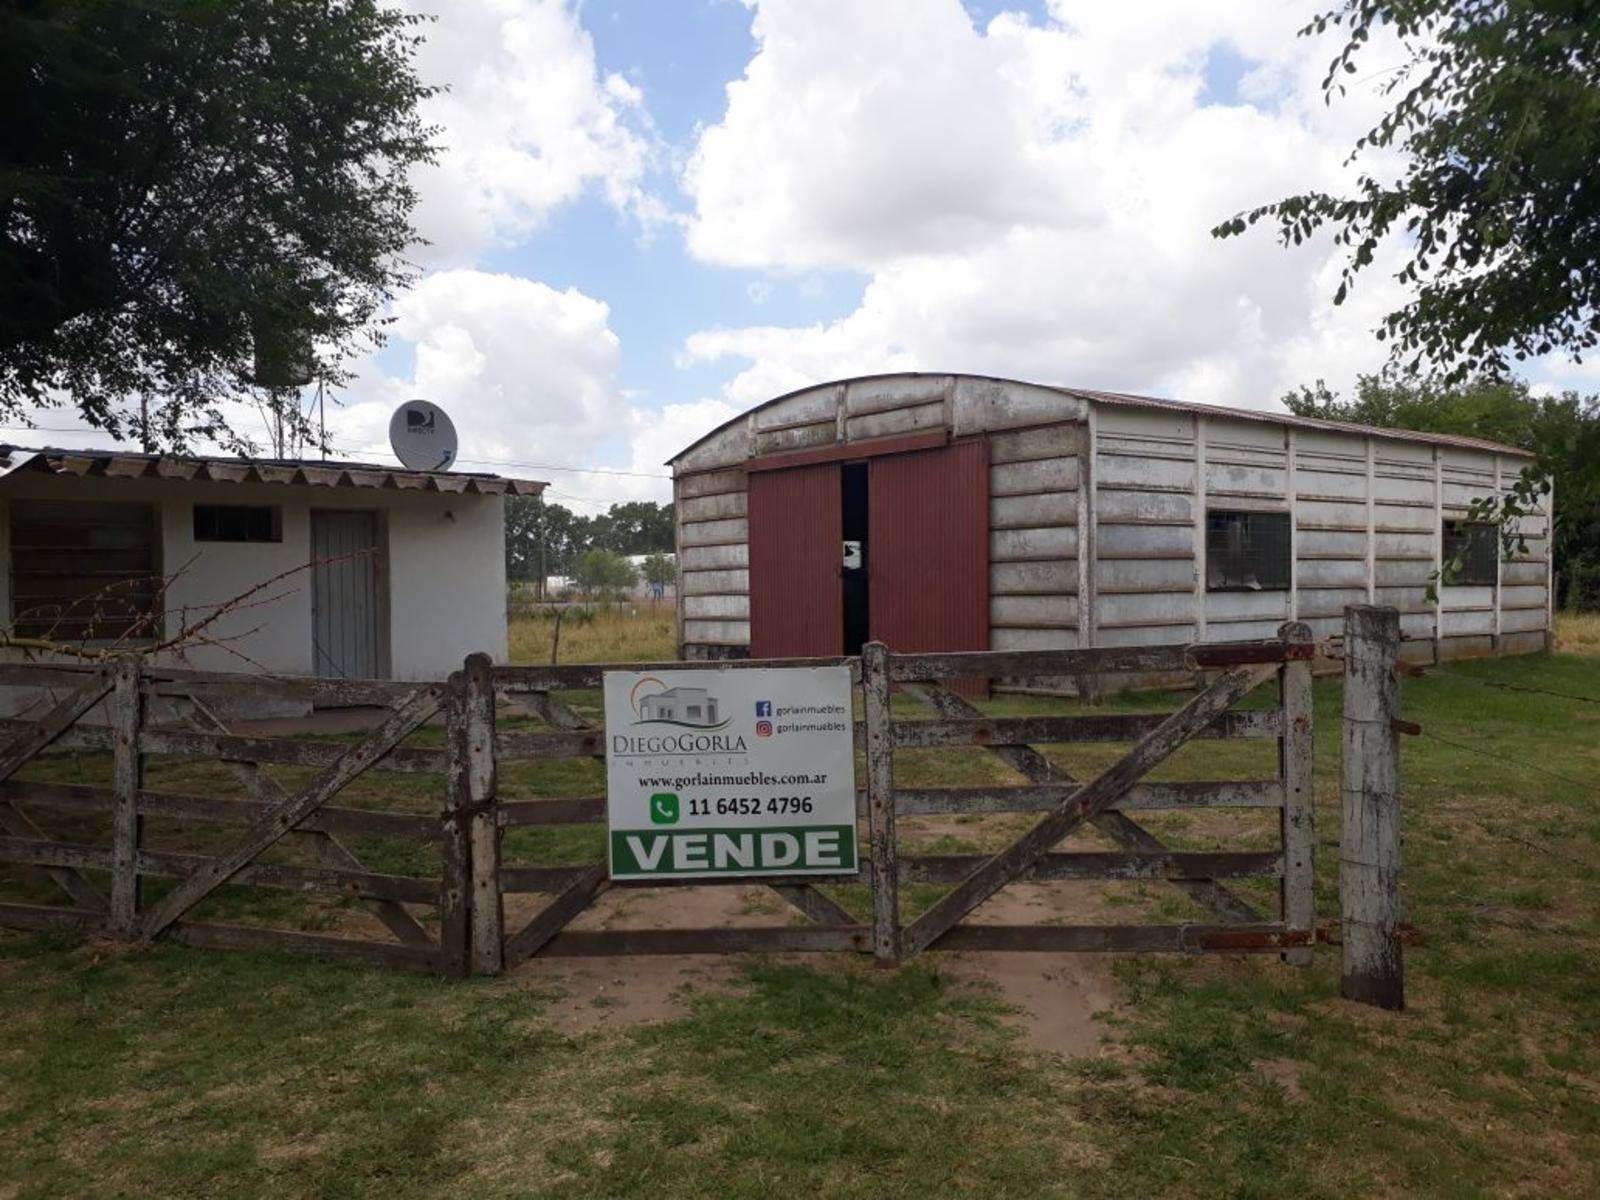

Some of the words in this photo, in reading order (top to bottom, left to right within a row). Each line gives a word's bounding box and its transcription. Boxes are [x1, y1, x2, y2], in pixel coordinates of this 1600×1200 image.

[776, 704, 846, 717] gorlainmuebles
[776, 721, 846, 734] gorlainmuebles
[639, 772, 827, 790] www.gorlainmuebles.com.ar
[689, 799, 711, 815] 11
[717, 797, 761, 815] 6452
[768, 796, 813, 814] 4796
[626, 831, 841, 870] VENDE
